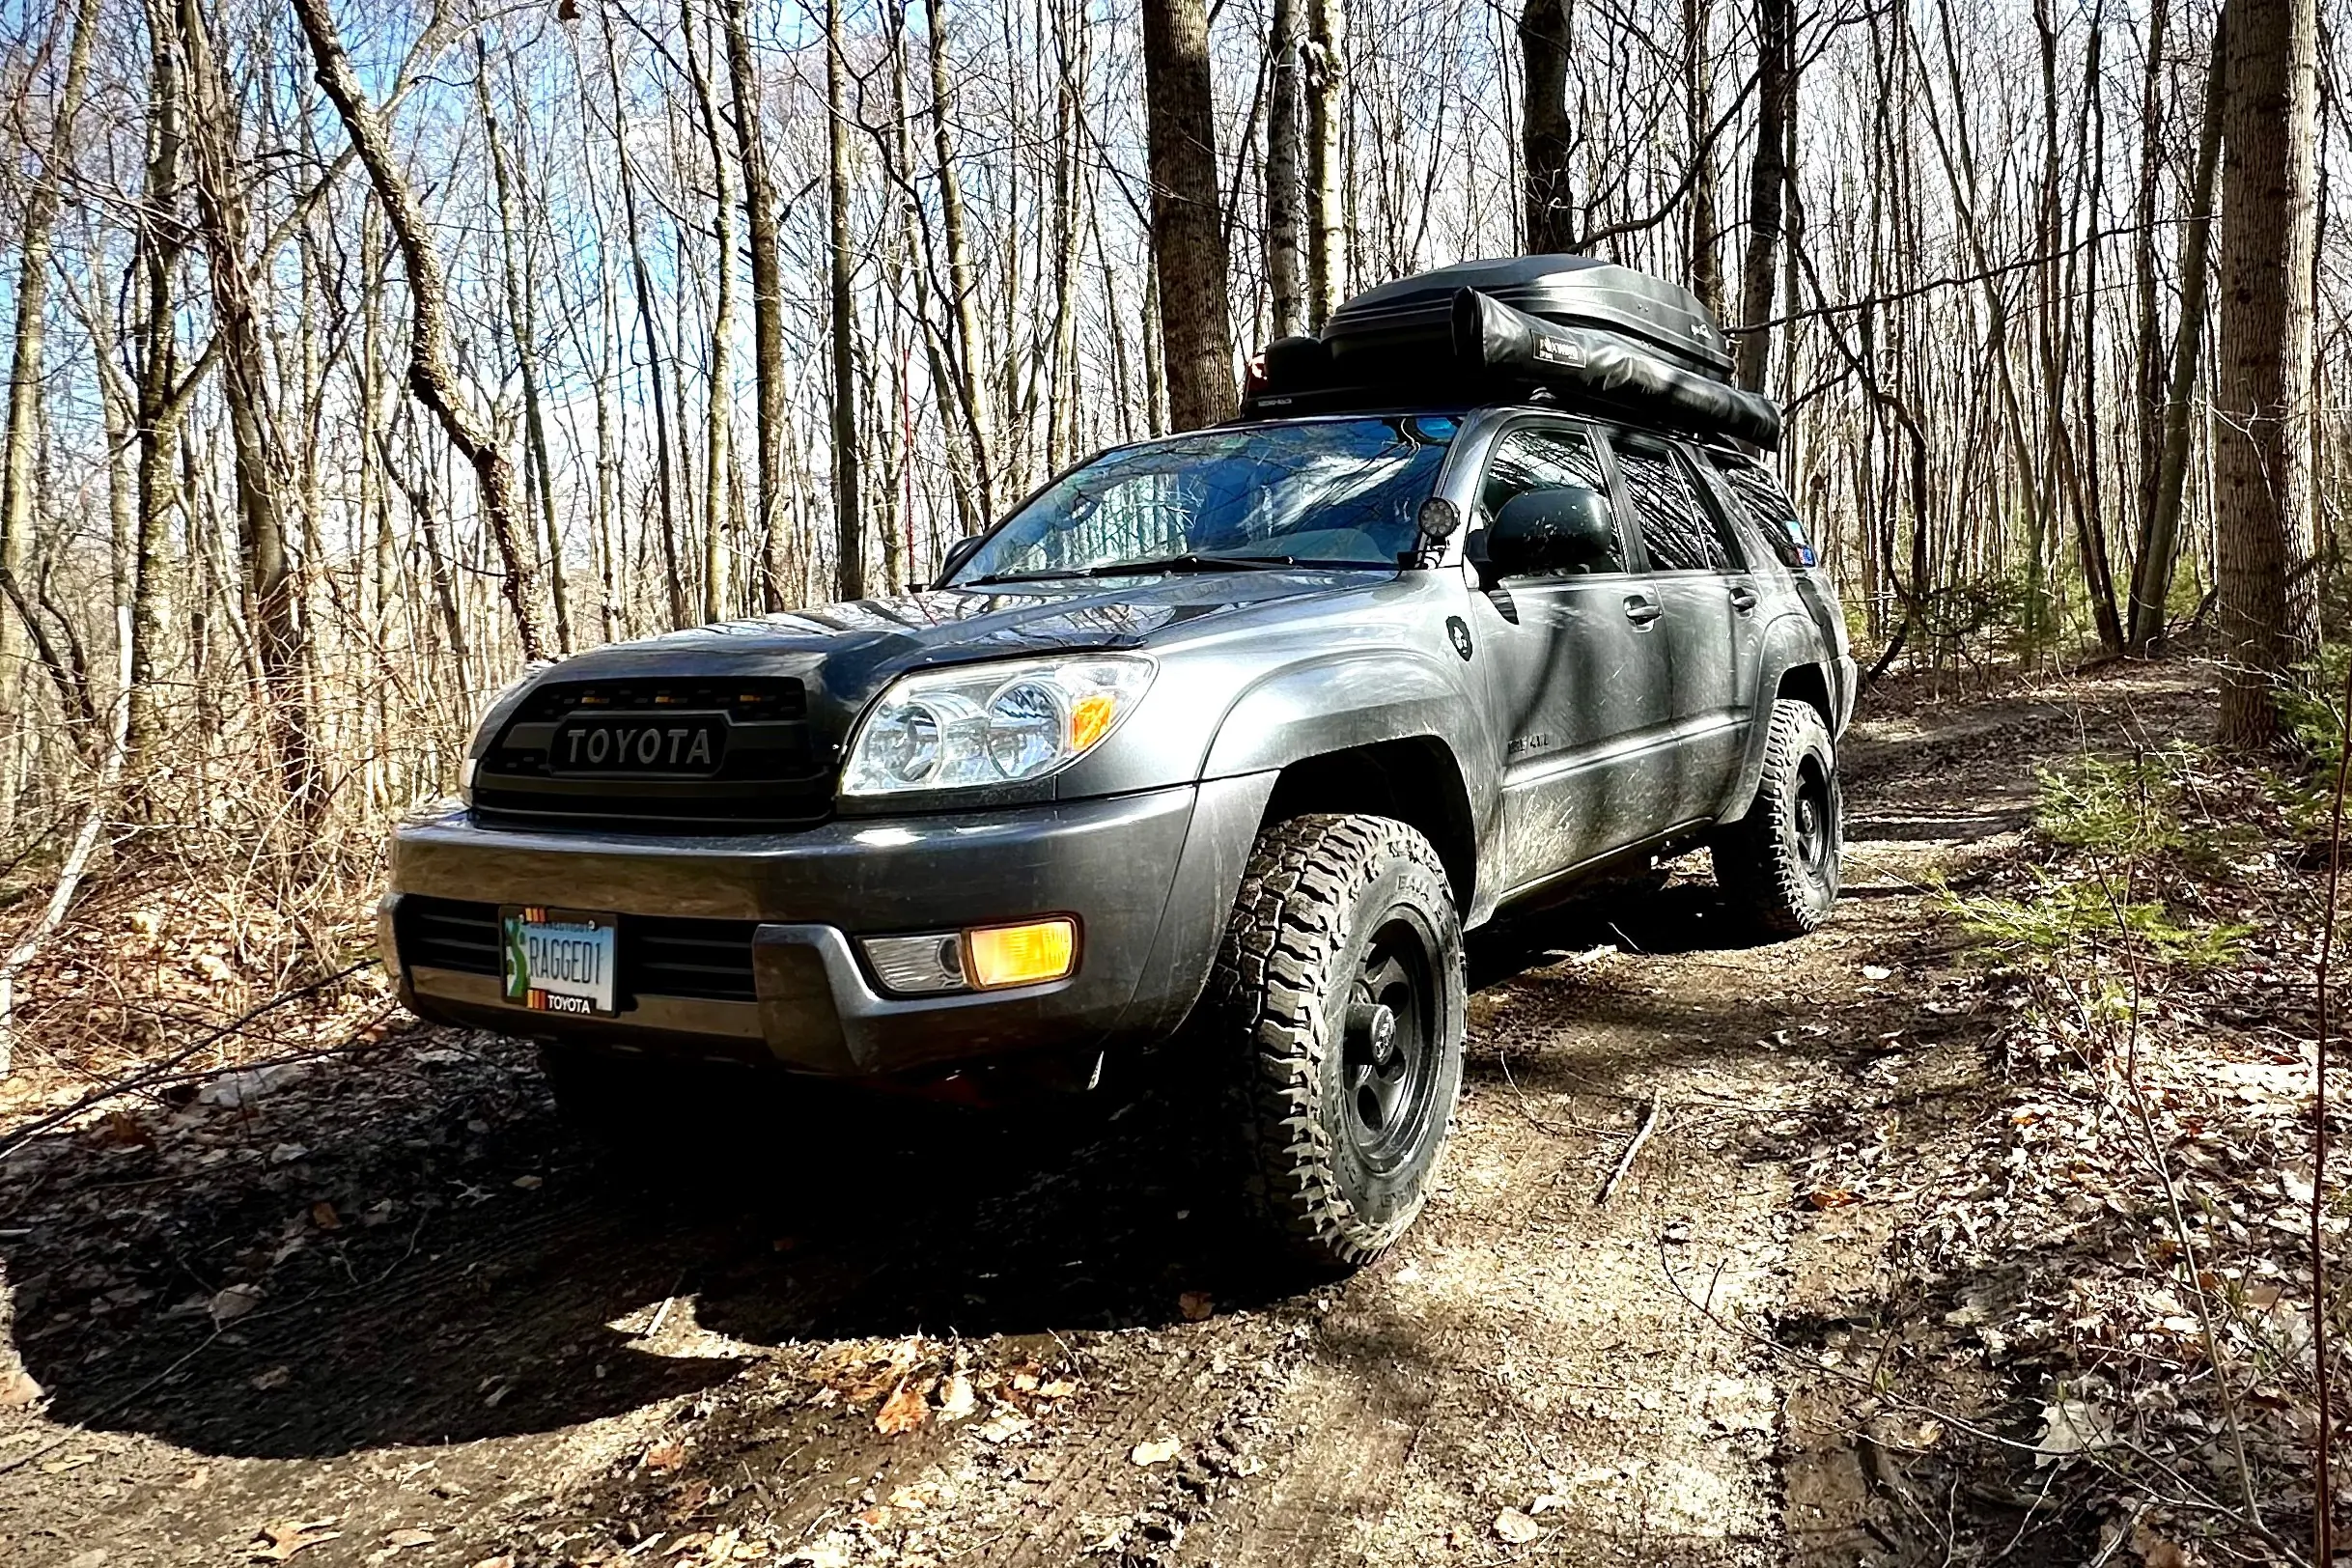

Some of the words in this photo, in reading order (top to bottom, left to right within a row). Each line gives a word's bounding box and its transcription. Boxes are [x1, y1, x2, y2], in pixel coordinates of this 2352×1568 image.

[567, 728, 711, 765] TOYOTA
[529, 936, 601, 985] RAGGED1
[547, 994, 591, 1014] TOYOTA
